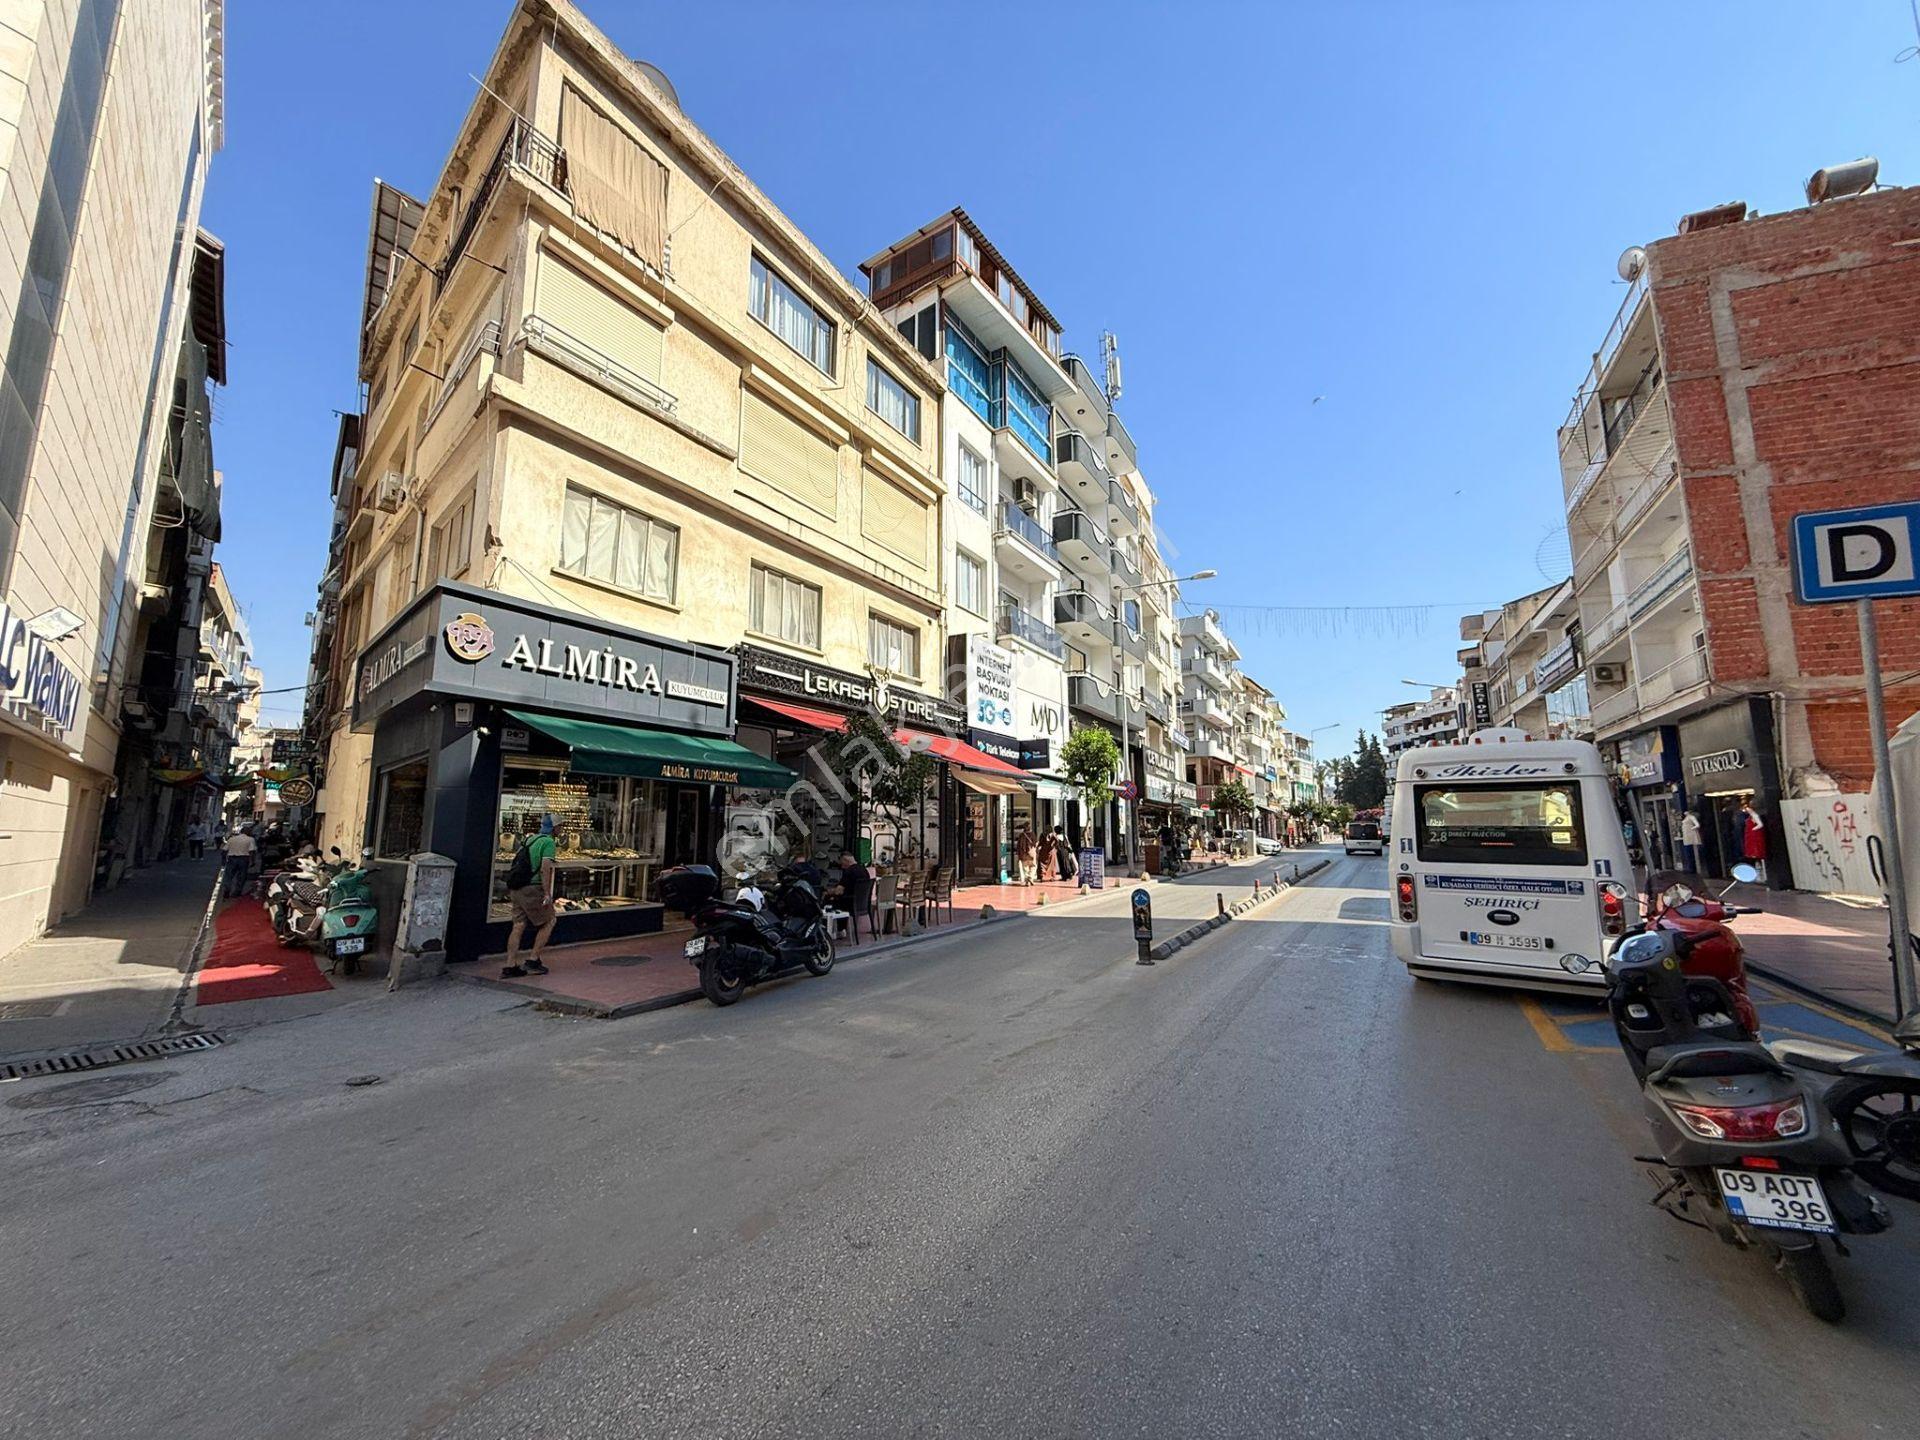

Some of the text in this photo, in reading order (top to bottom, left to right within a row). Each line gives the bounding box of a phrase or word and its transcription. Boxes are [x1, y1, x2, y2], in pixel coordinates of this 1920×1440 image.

[1827, 525, 1896, 582] D
[505, 634, 663, 693] ALMİRA
[977, 666, 1011, 688] BAŞVURU
[671, 681, 725, 702] KUYUMCULUK
[979, 682, 1010, 702] NOKTASI
[890, 695, 935, 721] STORE
[661, 763, 690, 779] ALMİRA
[1401, 839, 1411, 853] 1
[1429, 831, 1448, 842] 2.8
[1596, 861, 1609, 877] 1
[1464, 896, 1541, 911] ŞEHİRİÇİ
[1477, 934, 1491, 944] 09
[1722, 1172, 1813, 1199] 09 AOT
[1771, 1198, 1826, 1223] 396
